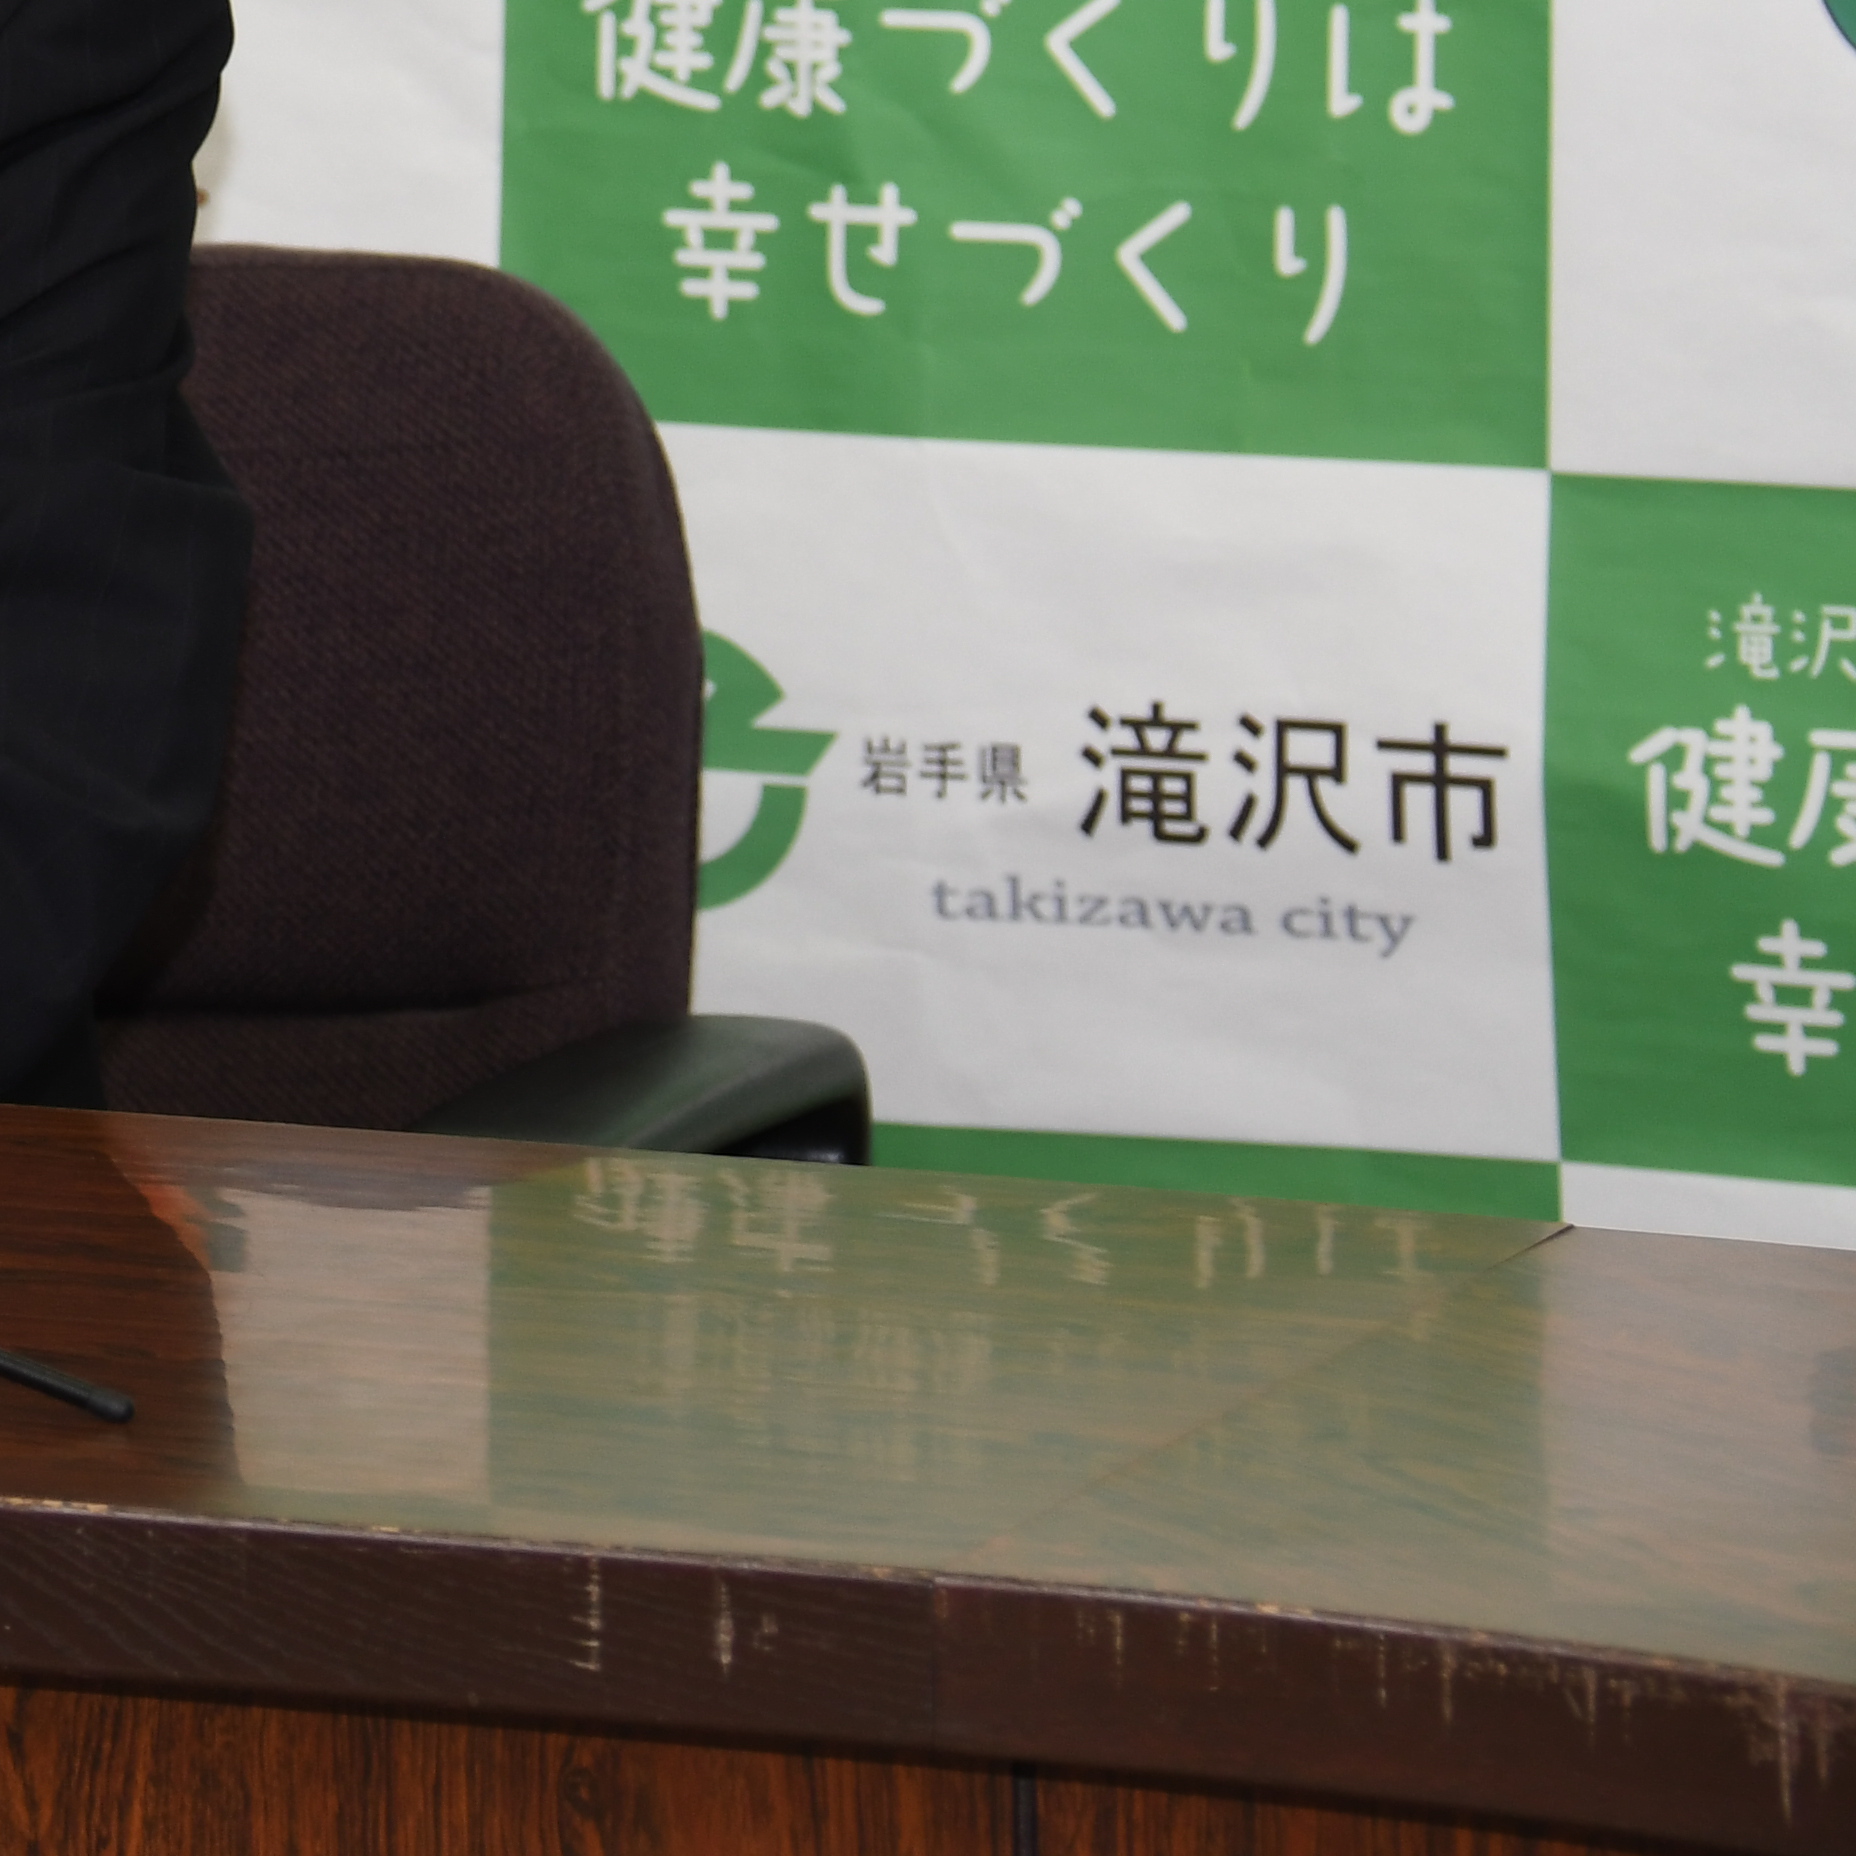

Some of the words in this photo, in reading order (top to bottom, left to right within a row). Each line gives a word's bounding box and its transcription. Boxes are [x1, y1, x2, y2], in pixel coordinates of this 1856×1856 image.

[661, 160, 1349, 347] 幸せづくり
[859, 735, 1029, 804] 岩手県
[1076, 699, 1511, 866] 滝沢市
[930, 872, 1258, 939] takizawa
[1277, 894, 1416, 961] city
[1729, 917, 1856, 1077] 幸
